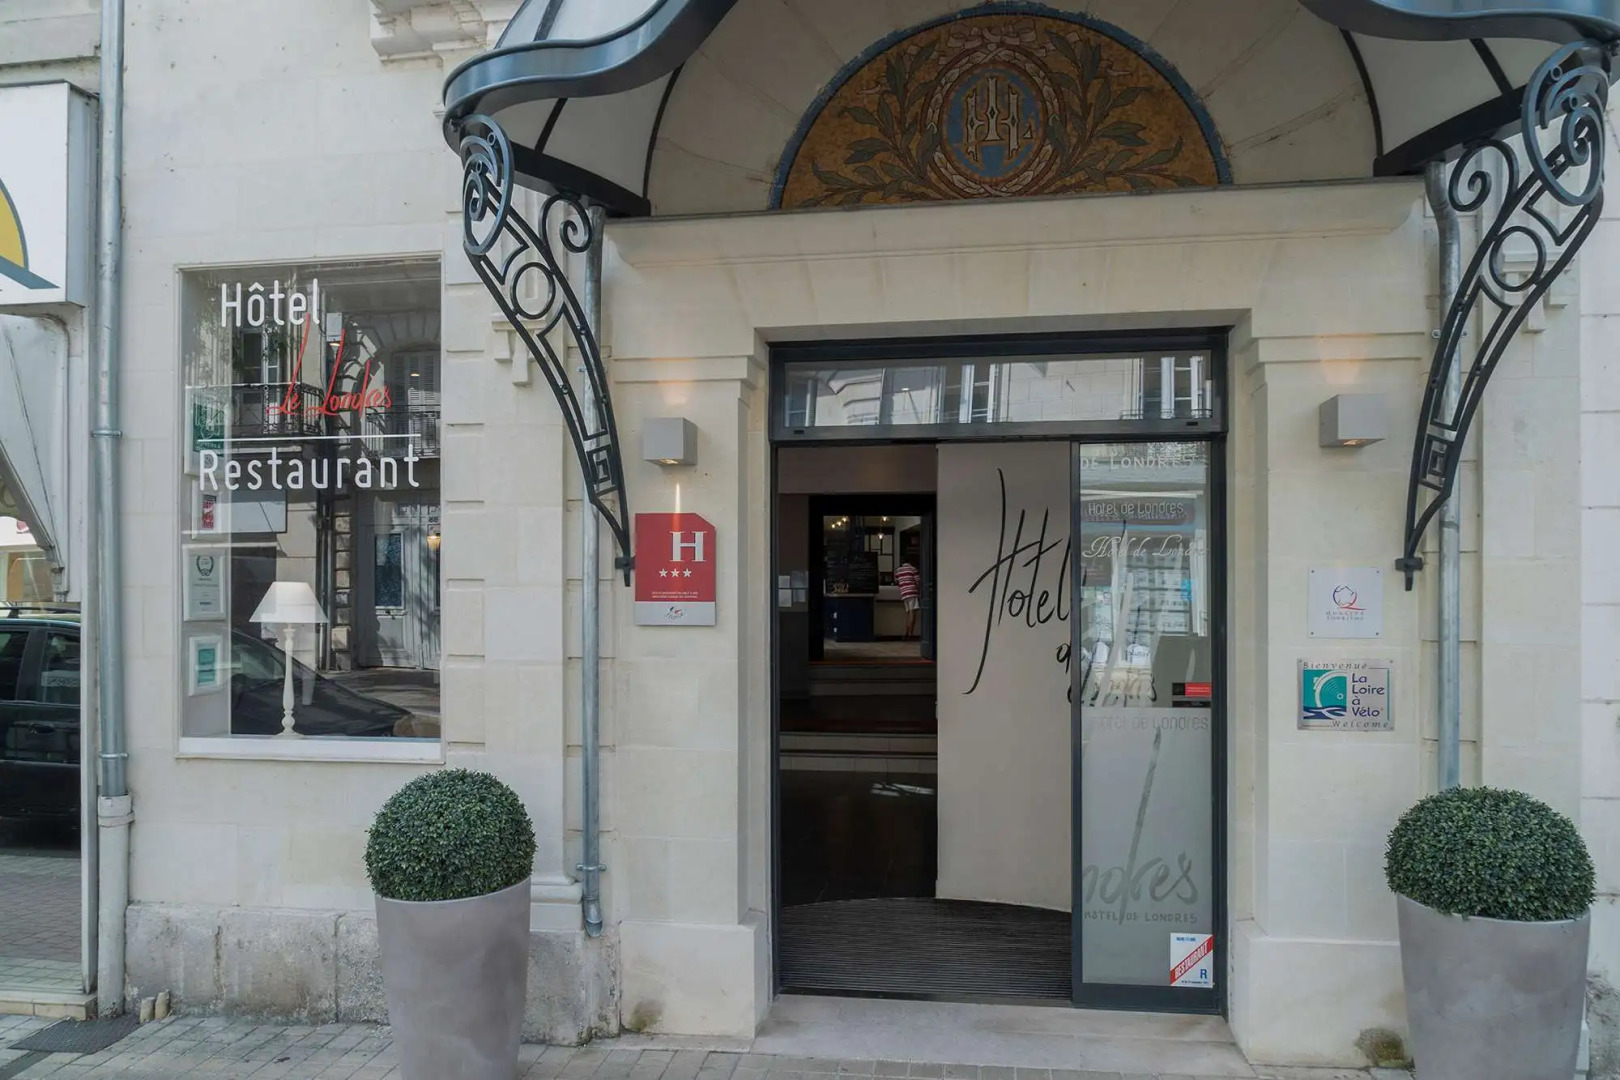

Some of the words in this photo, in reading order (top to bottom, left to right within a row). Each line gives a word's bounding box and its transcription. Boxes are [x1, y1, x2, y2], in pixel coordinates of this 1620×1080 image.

[220, 278, 320, 327] Hôtel
[265, 311, 310, 415] Le
[199, 443, 420, 490] Restaurant
[1110, 455, 1193, 470] LONDRES
[1137, 501, 1185, 515] Londres
[669, 531, 708, 562] H
[1351, 673, 1368, 684] La
[1351, 684, 1386, 695] Loire
[1351, 696, 1361, 706] à
[1351, 706, 1381, 718] Vélo
[1332, 720, 1389, 729] Welcome
[1144, 912, 1199, 924] LONDRES
[1199, 968, 1208, 979] R
